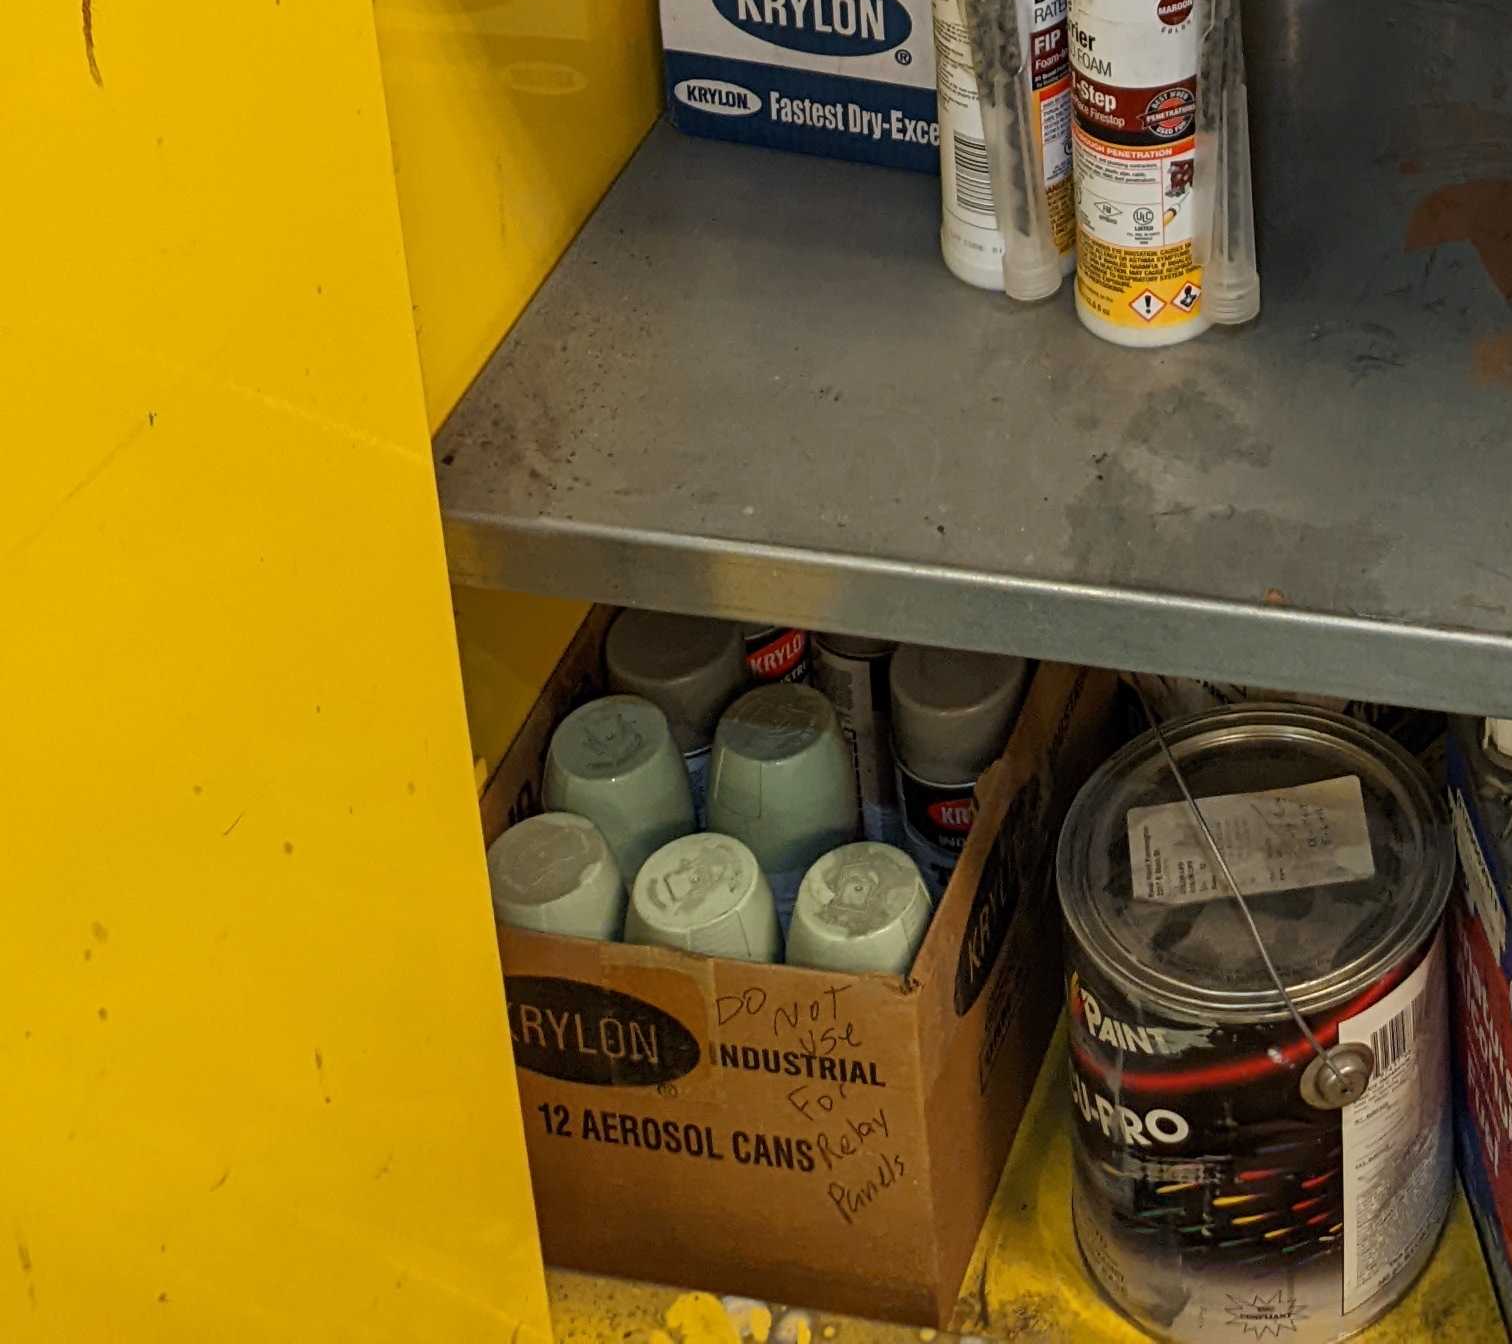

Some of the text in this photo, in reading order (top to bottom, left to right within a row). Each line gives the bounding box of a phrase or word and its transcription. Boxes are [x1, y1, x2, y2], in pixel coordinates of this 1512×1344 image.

[1078, 48, 1112, 78] FOAM
[687, 84, 750, 109] KRYLON
[770, 91, 843, 132] Fastest
[1106, 148, 1173, 160] PENETRATION
[750, 633, 807, 675] KRYLO
[715, 986, 767, 1026] DO
[508, 1004, 659, 1064] RYLON
[708, 1041, 887, 1087] INDUSTRIAL
[537, 1103, 816, 1173] 12 AEROSOL CANS
